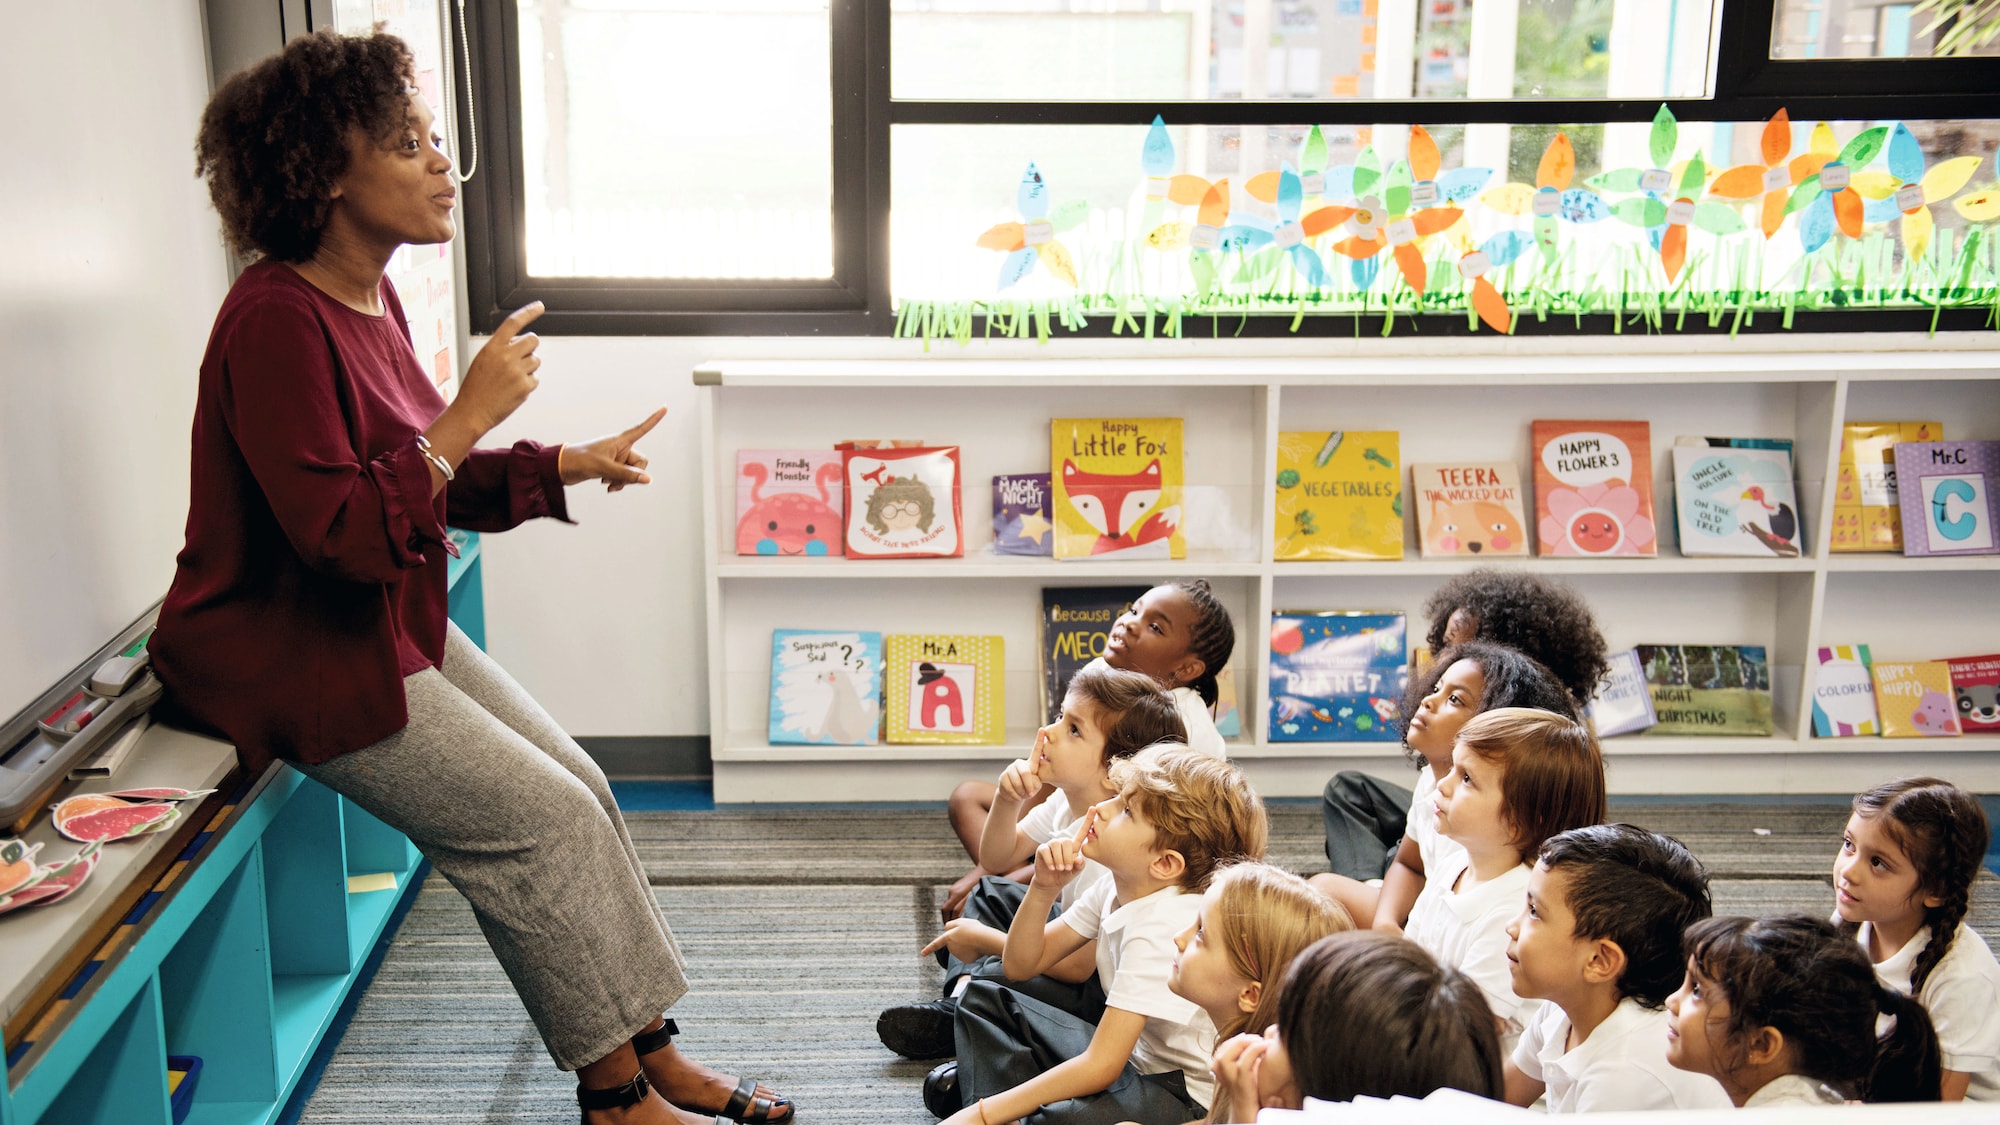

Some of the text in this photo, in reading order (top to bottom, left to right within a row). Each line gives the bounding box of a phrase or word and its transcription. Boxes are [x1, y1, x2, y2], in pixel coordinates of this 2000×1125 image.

[1102, 420, 1138, 436] Happy
[1073, 434, 1168, 457] Little Fox
[776, 458, 810, 471] Friendly
[1557, 452, 1620, 473] FLOWER 3
[1931, 448, 1968, 465] Mr.C
[775, 471, 811, 481] Monster
[1436, 467, 1500, 487] TEERA
[1692, 460, 1726, 481] UNCLE
[1697, 467, 1733, 490] VULTURE
[999, 478, 1040, 493] MAGIC
[1303, 480, 1393, 497] VEGETABLES
[1003, 490, 1044, 505] NIGHT
[1424, 487, 1515, 502] THE WICKED CAT
[1694, 499, 1730, 516] ON THE
[1699, 511, 1722, 524] OLD
[1695, 519, 1722, 535] TREE
[1053, 604, 1111, 622] Because
[792, 641, 839, 652] Suspicious
[923, 642, 958, 656] Mr.A
[1053, 631, 1109, 661] MEO
[807, 651, 826, 663] Seal
[1877, 664, 1914, 683] HIPPY
[1287, 670, 1382, 697] PLANET
[1817, 681, 1872, 698] COLORFU
[1883, 681, 1923, 697] HIPPO
[1655, 688, 1692, 704] NIGHT
[1657, 709, 1727, 726] CHRISTMAS
